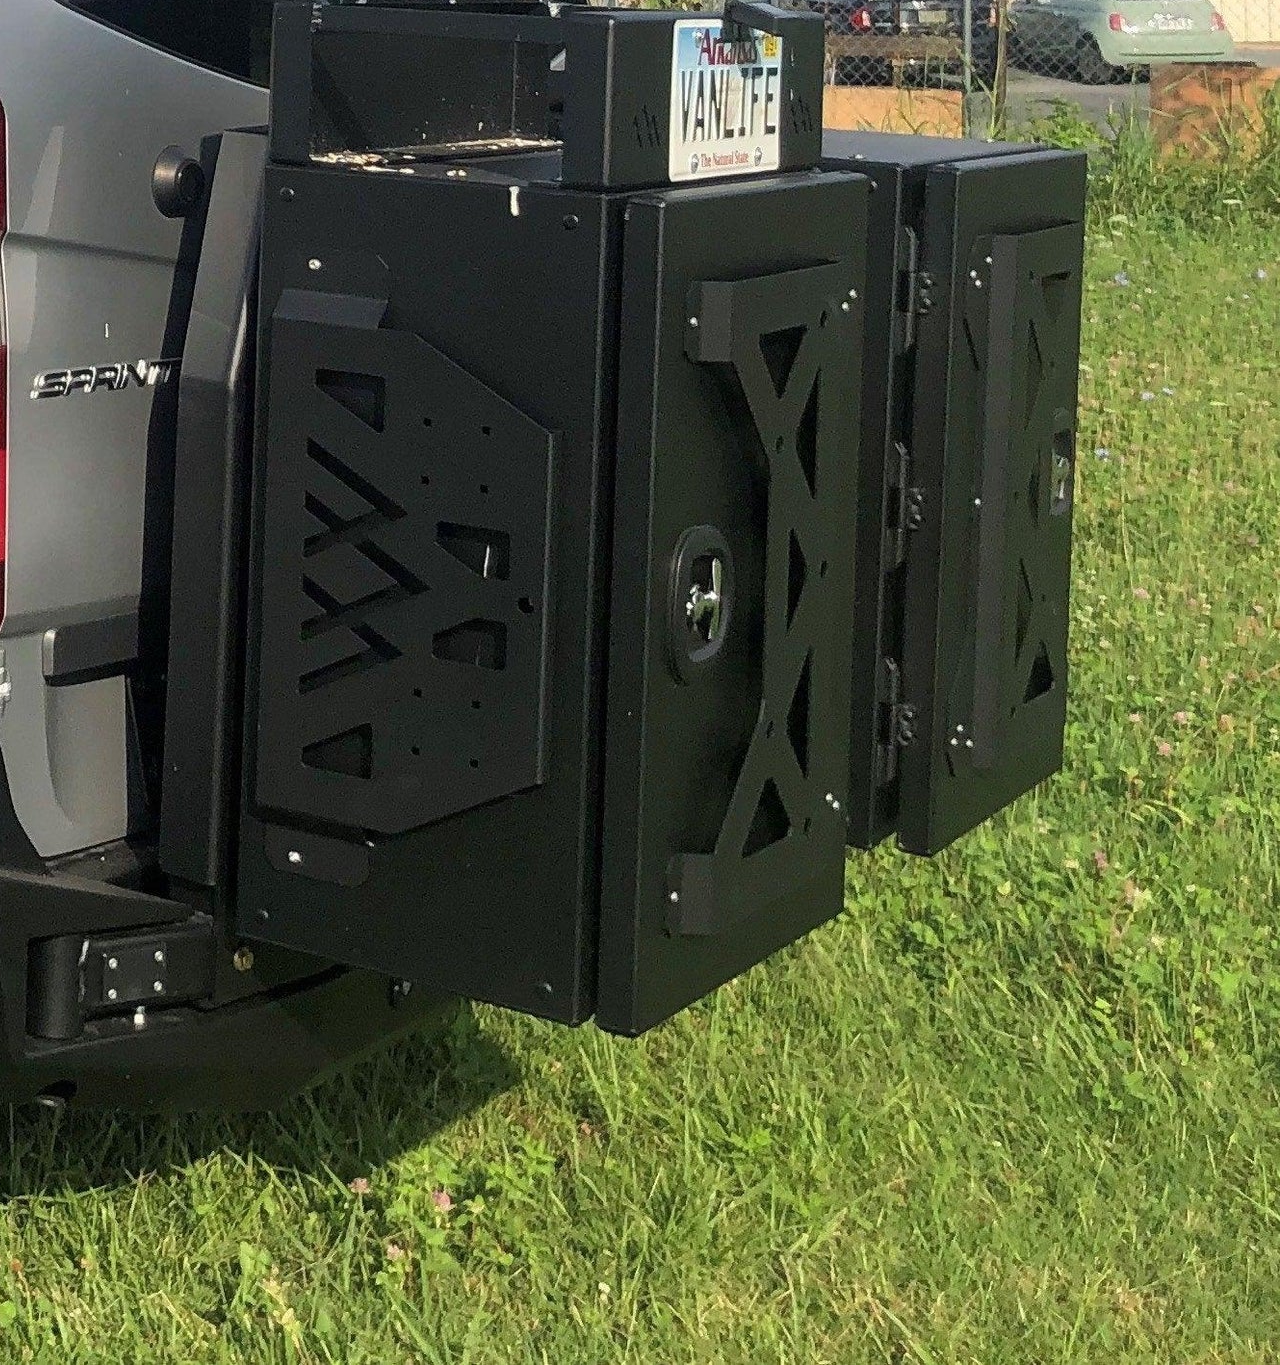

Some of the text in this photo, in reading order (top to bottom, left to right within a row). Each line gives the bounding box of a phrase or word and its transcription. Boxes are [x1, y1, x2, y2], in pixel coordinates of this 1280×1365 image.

[681, 66, 778, 144] VANLIFE
[701, 149, 749, 168] The Natural State
